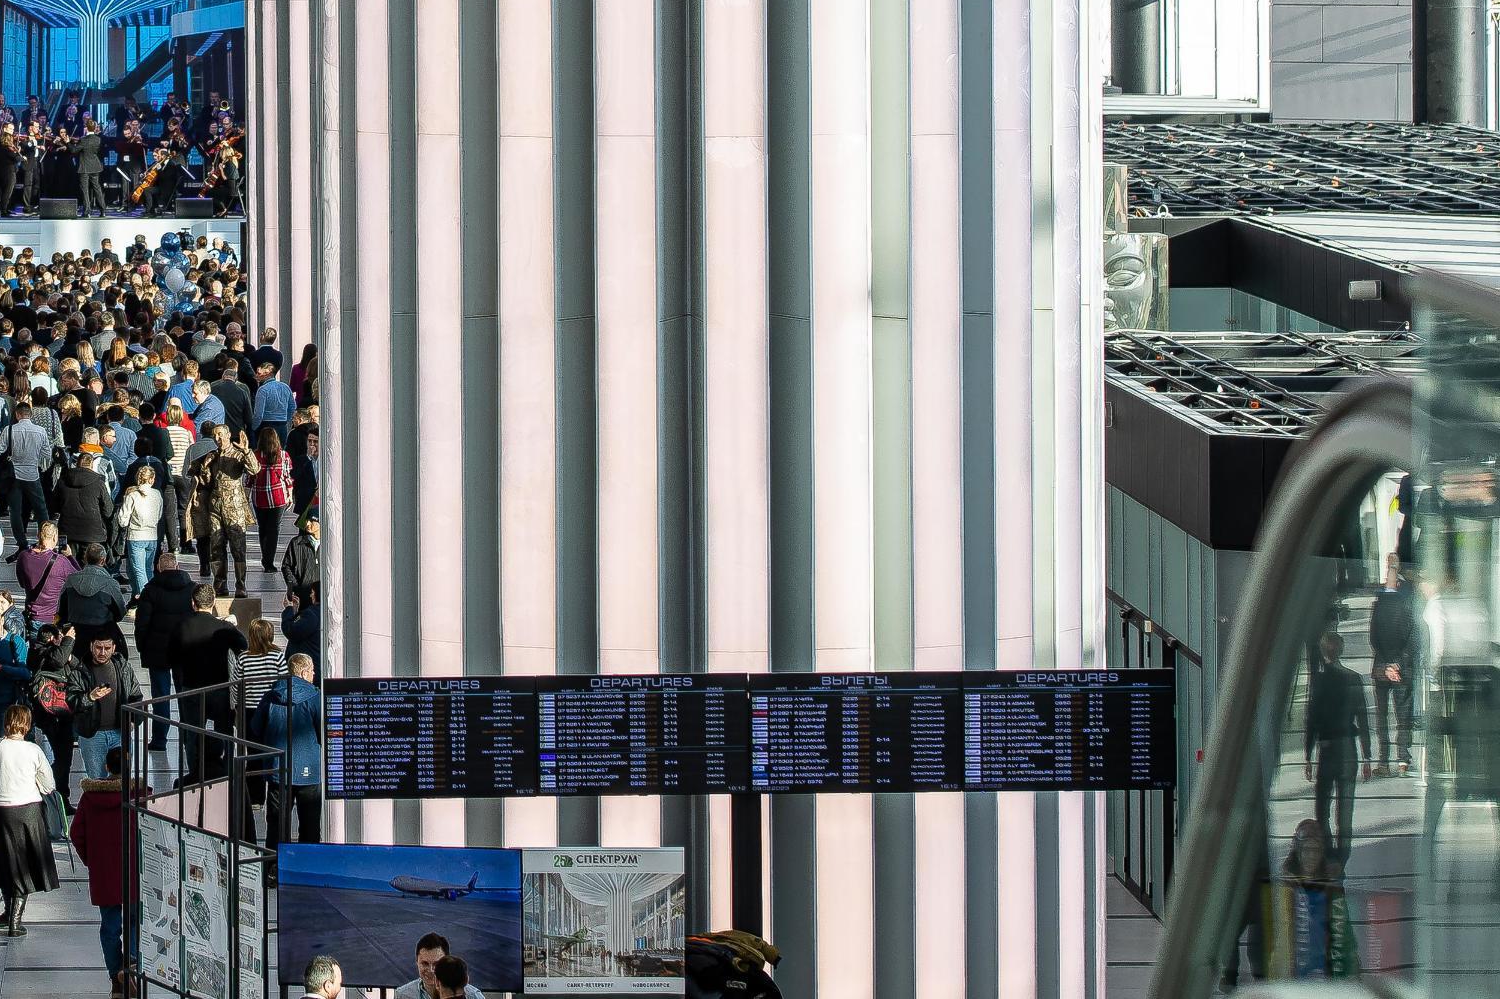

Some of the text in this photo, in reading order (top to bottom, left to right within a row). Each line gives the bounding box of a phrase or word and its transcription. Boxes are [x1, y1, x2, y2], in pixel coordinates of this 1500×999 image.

[590, 677, 693, 688] DEPARTURES
[821, 675, 888, 685] ВЫЛЕТЫ
[1016, 672, 1119, 683] DEPARTURES
[378, 680, 480, 690] DEPARTURES
[575, 854, 639, 864] СПЕКТРУМ
